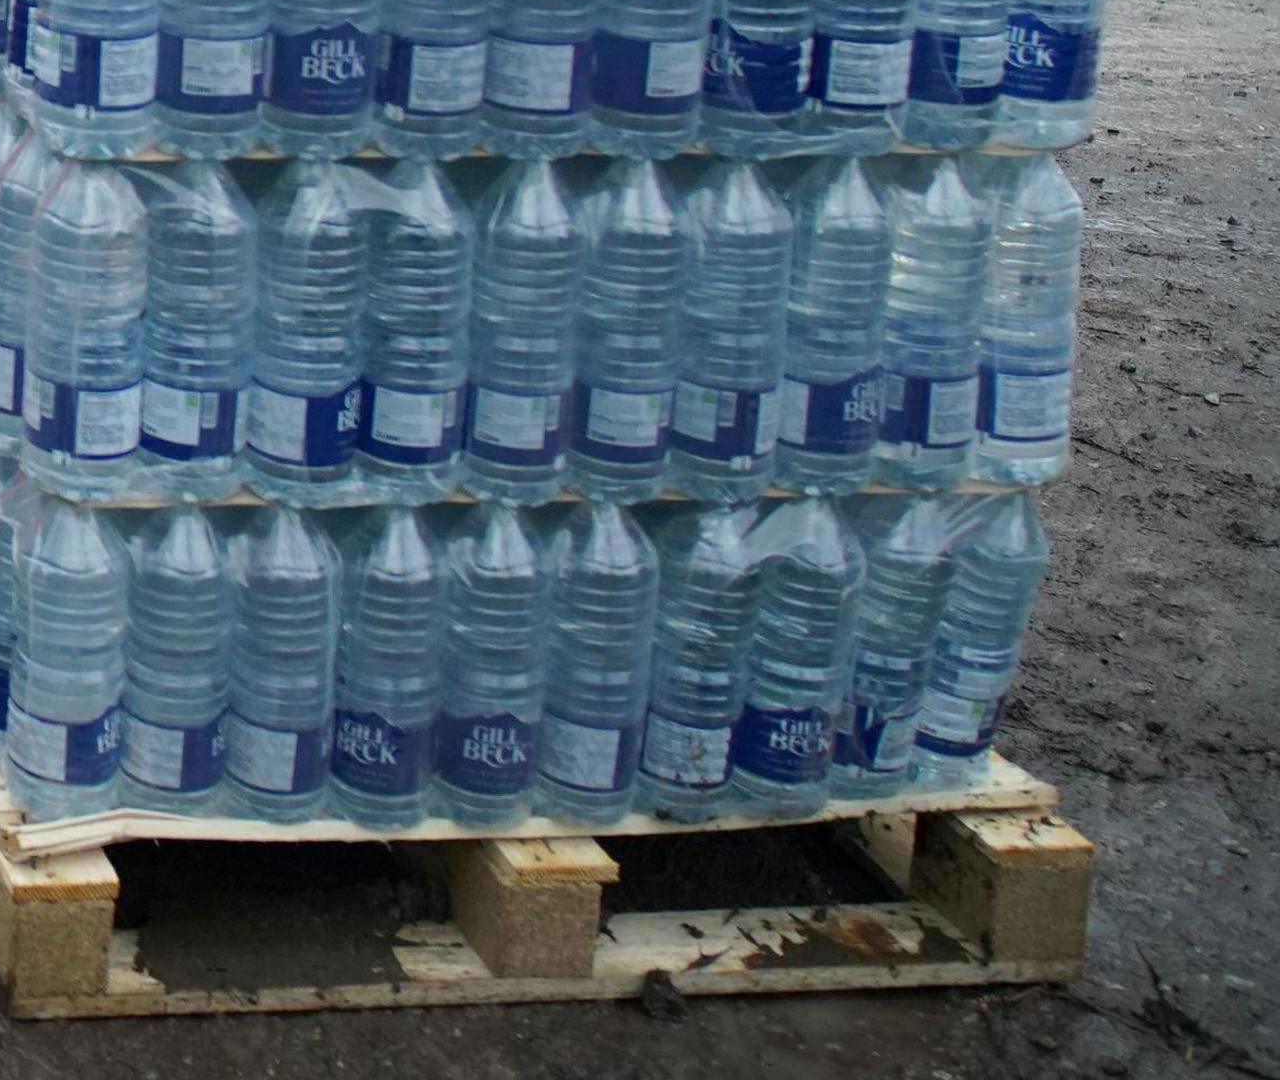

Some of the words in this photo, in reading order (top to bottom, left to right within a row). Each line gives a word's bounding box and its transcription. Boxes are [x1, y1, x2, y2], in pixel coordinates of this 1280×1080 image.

[310, 39, 357, 57] GILL
[301, 55, 366, 85] BECK
[472, 725, 518, 745] GILL
[463, 738, 527, 768] BECK
